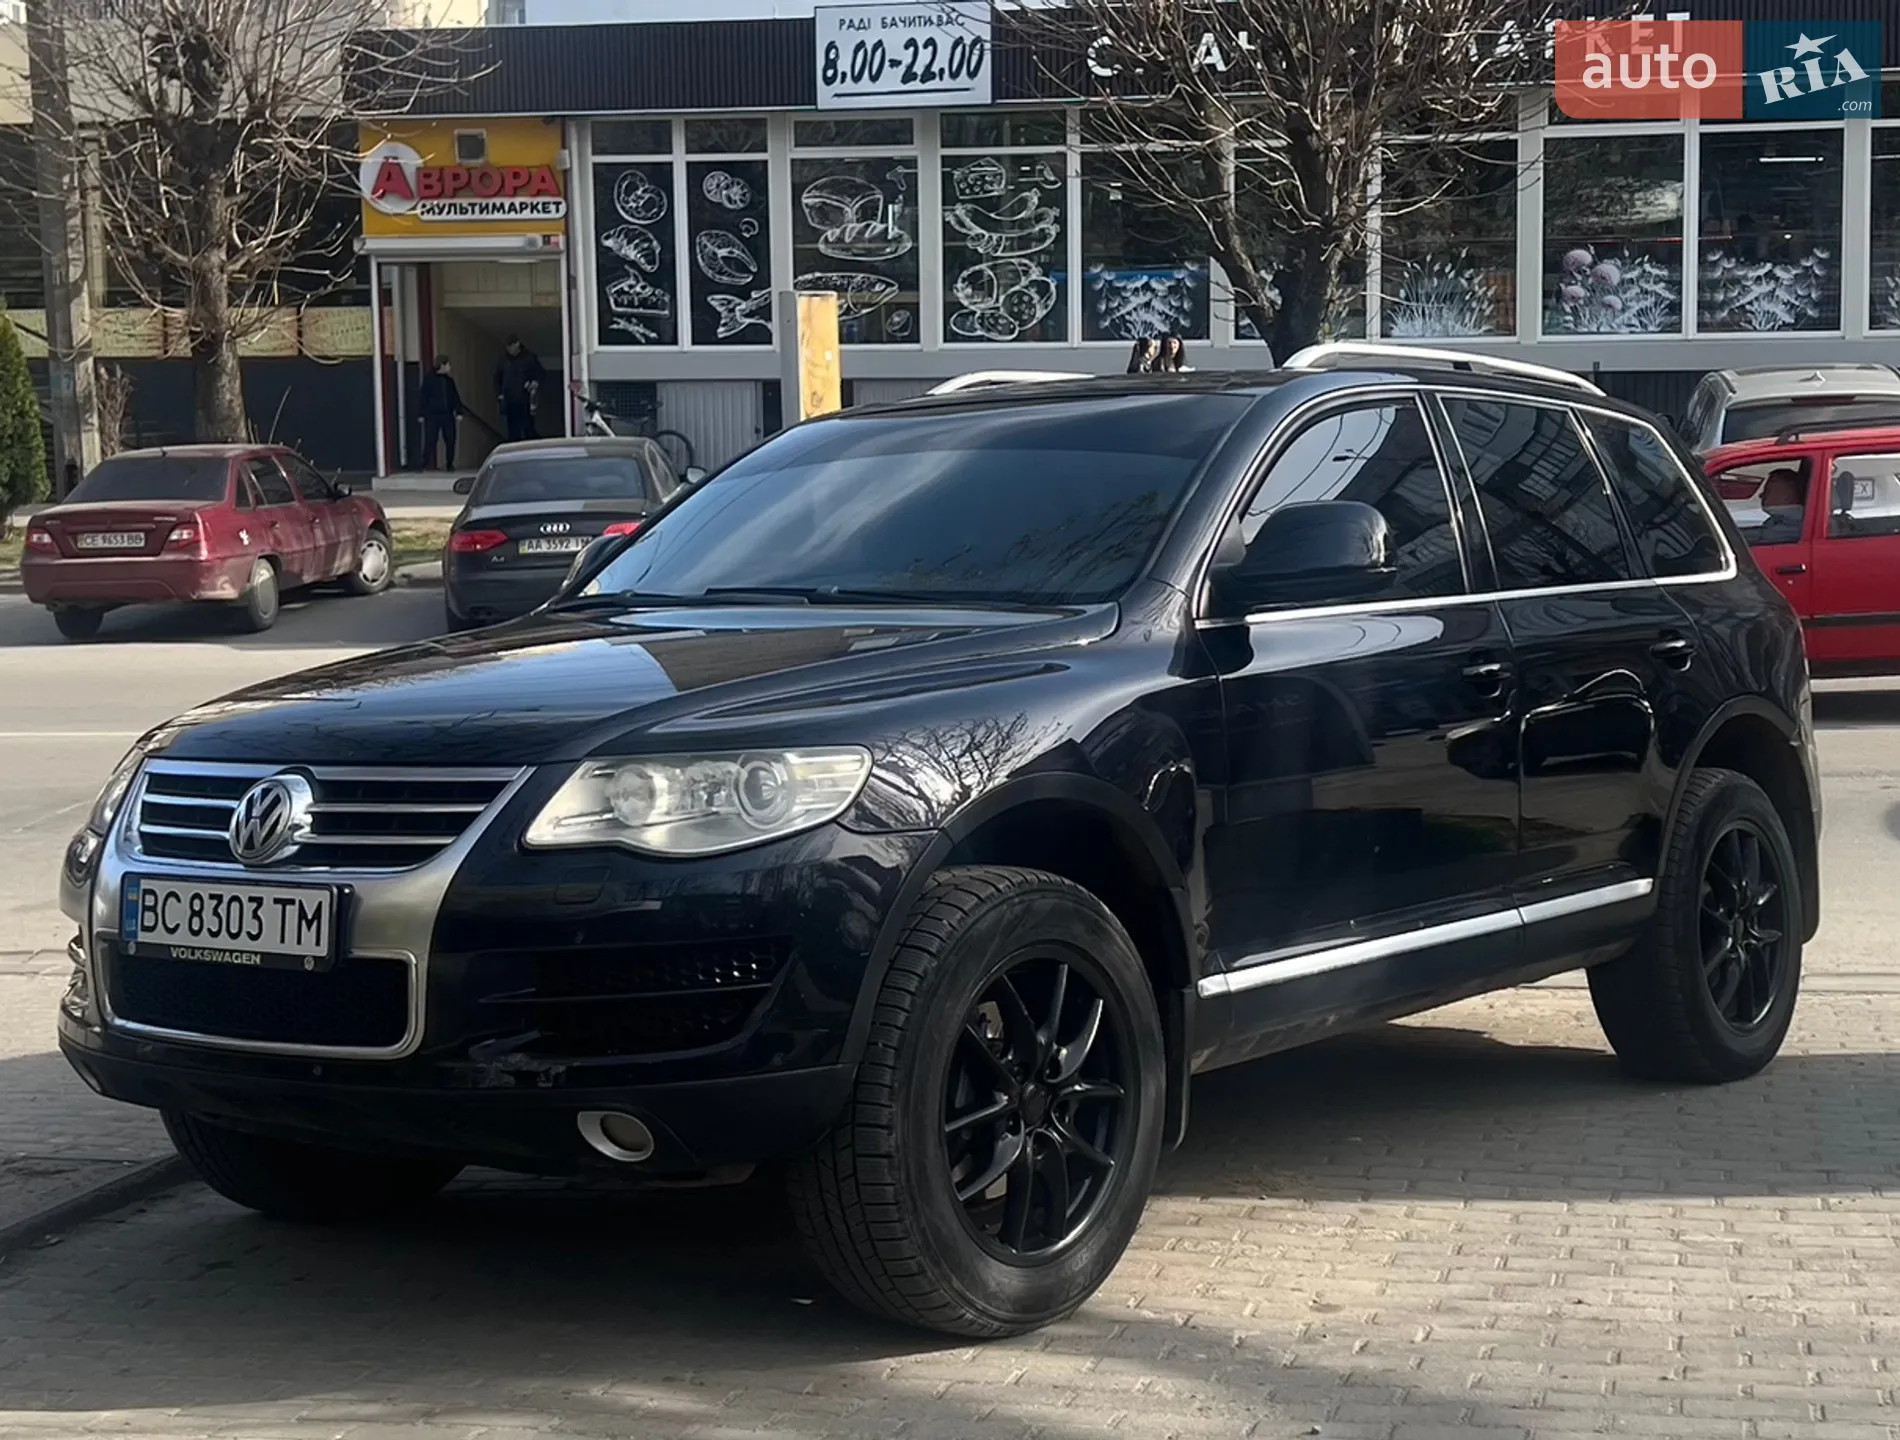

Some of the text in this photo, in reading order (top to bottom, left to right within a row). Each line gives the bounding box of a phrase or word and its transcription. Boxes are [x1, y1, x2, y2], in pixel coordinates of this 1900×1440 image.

[838, 13, 965, 31] РАДІ БАЧИТИ ВАС
[371, 161, 562, 200] АВРОРА
[420, 200, 563, 216] МУЛЬТИМАРКЕТ
[528, 539, 542, 551] AA
[547, 538, 571, 550] 3592
[139, 888, 323, 947] BC 8303 TM
[169, 946, 262, 966] VOLKSWAGEN
